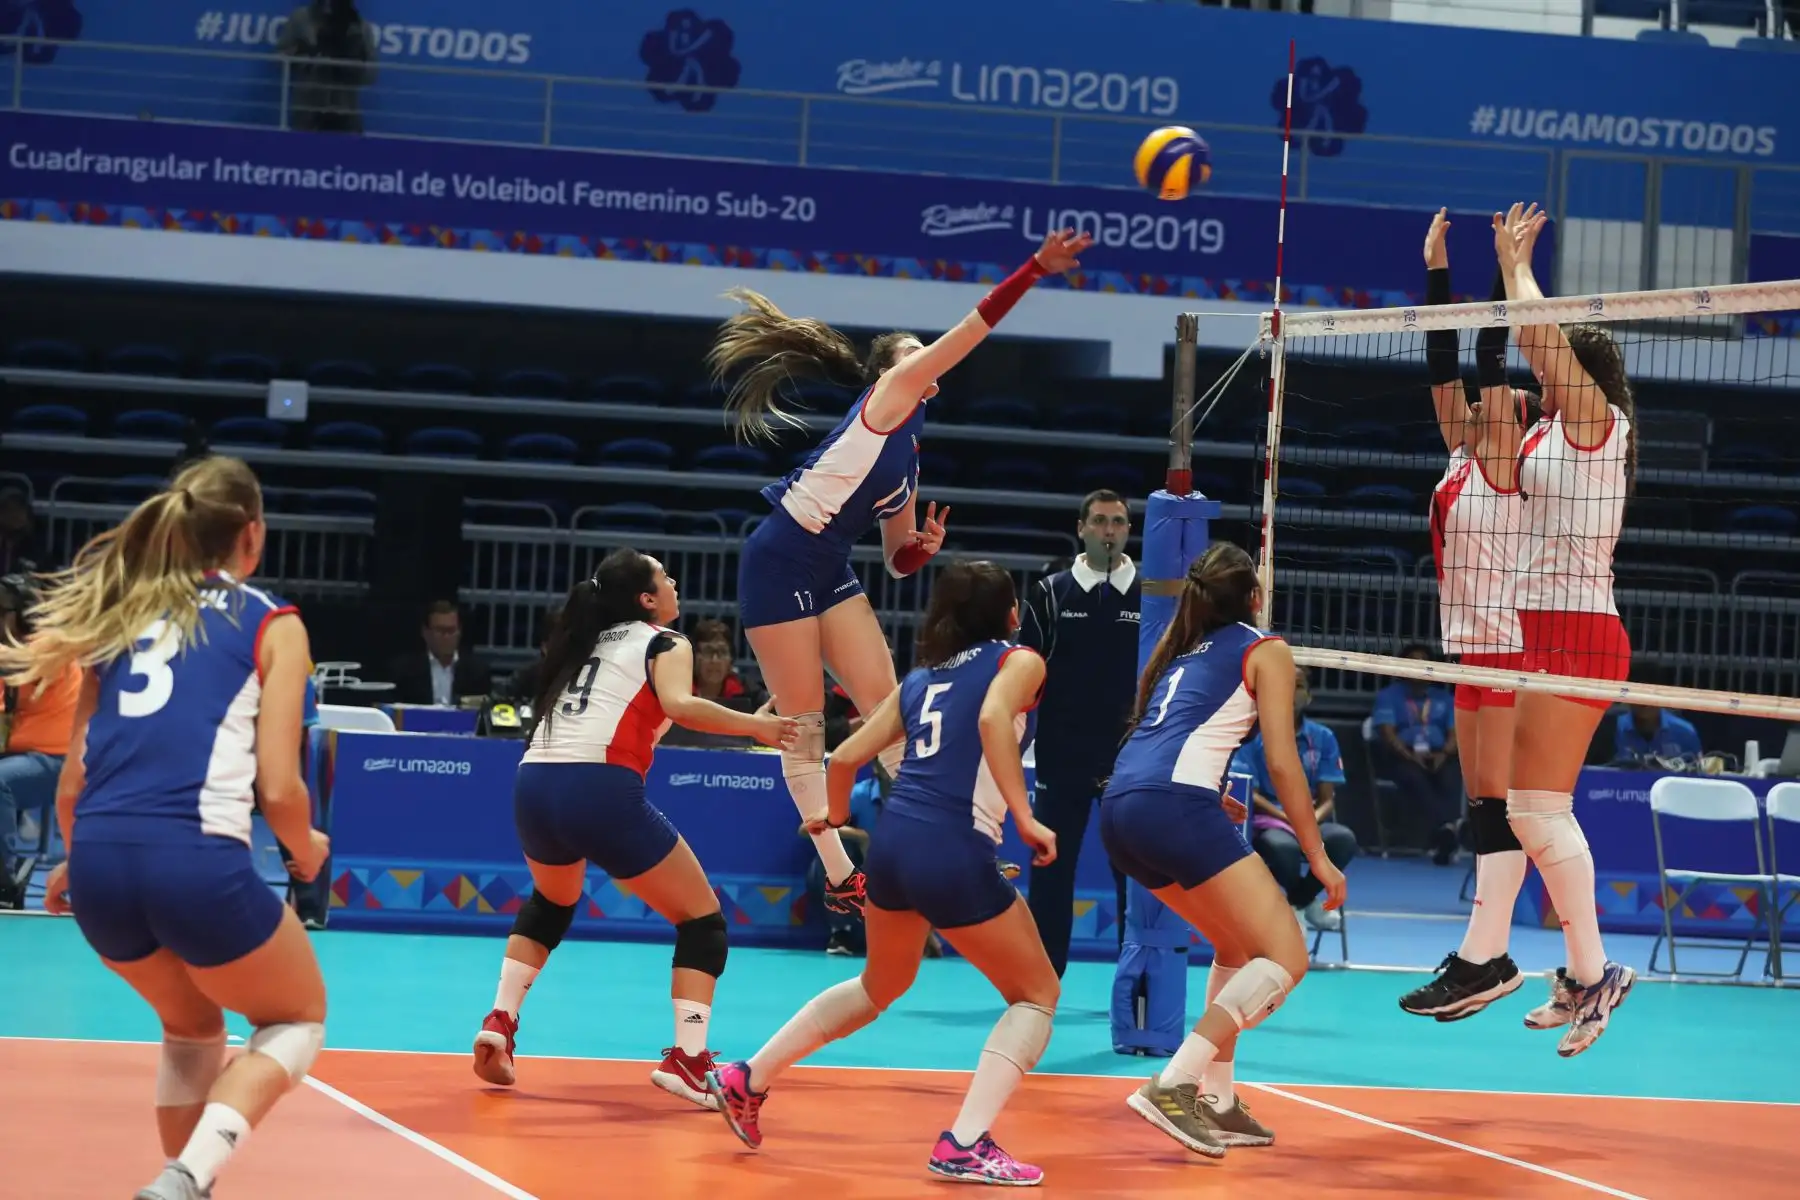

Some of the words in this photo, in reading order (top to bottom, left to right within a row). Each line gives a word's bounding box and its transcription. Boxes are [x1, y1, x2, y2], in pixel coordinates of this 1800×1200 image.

[195, 11, 532, 63] #JUGSTODOS
[1470, 105, 1776, 155] #JUGAMOSTODOS
[9, 143, 208, 182] Cuadrangular
[213, 157, 404, 195] Internacional
[411, 171, 446, 197] de
[452, 173, 567, 206] Voleibol
[573, 181, 709, 215] Femenino
[715, 191, 817, 222] Sub-20
[794, 591, 813, 611] 17
[118, 617, 183, 717] 3
[561, 656, 601, 716] 9
[1150, 666, 1185, 727] 1
[492, 703, 517, 727] 3
[915, 682, 953, 758] 5
